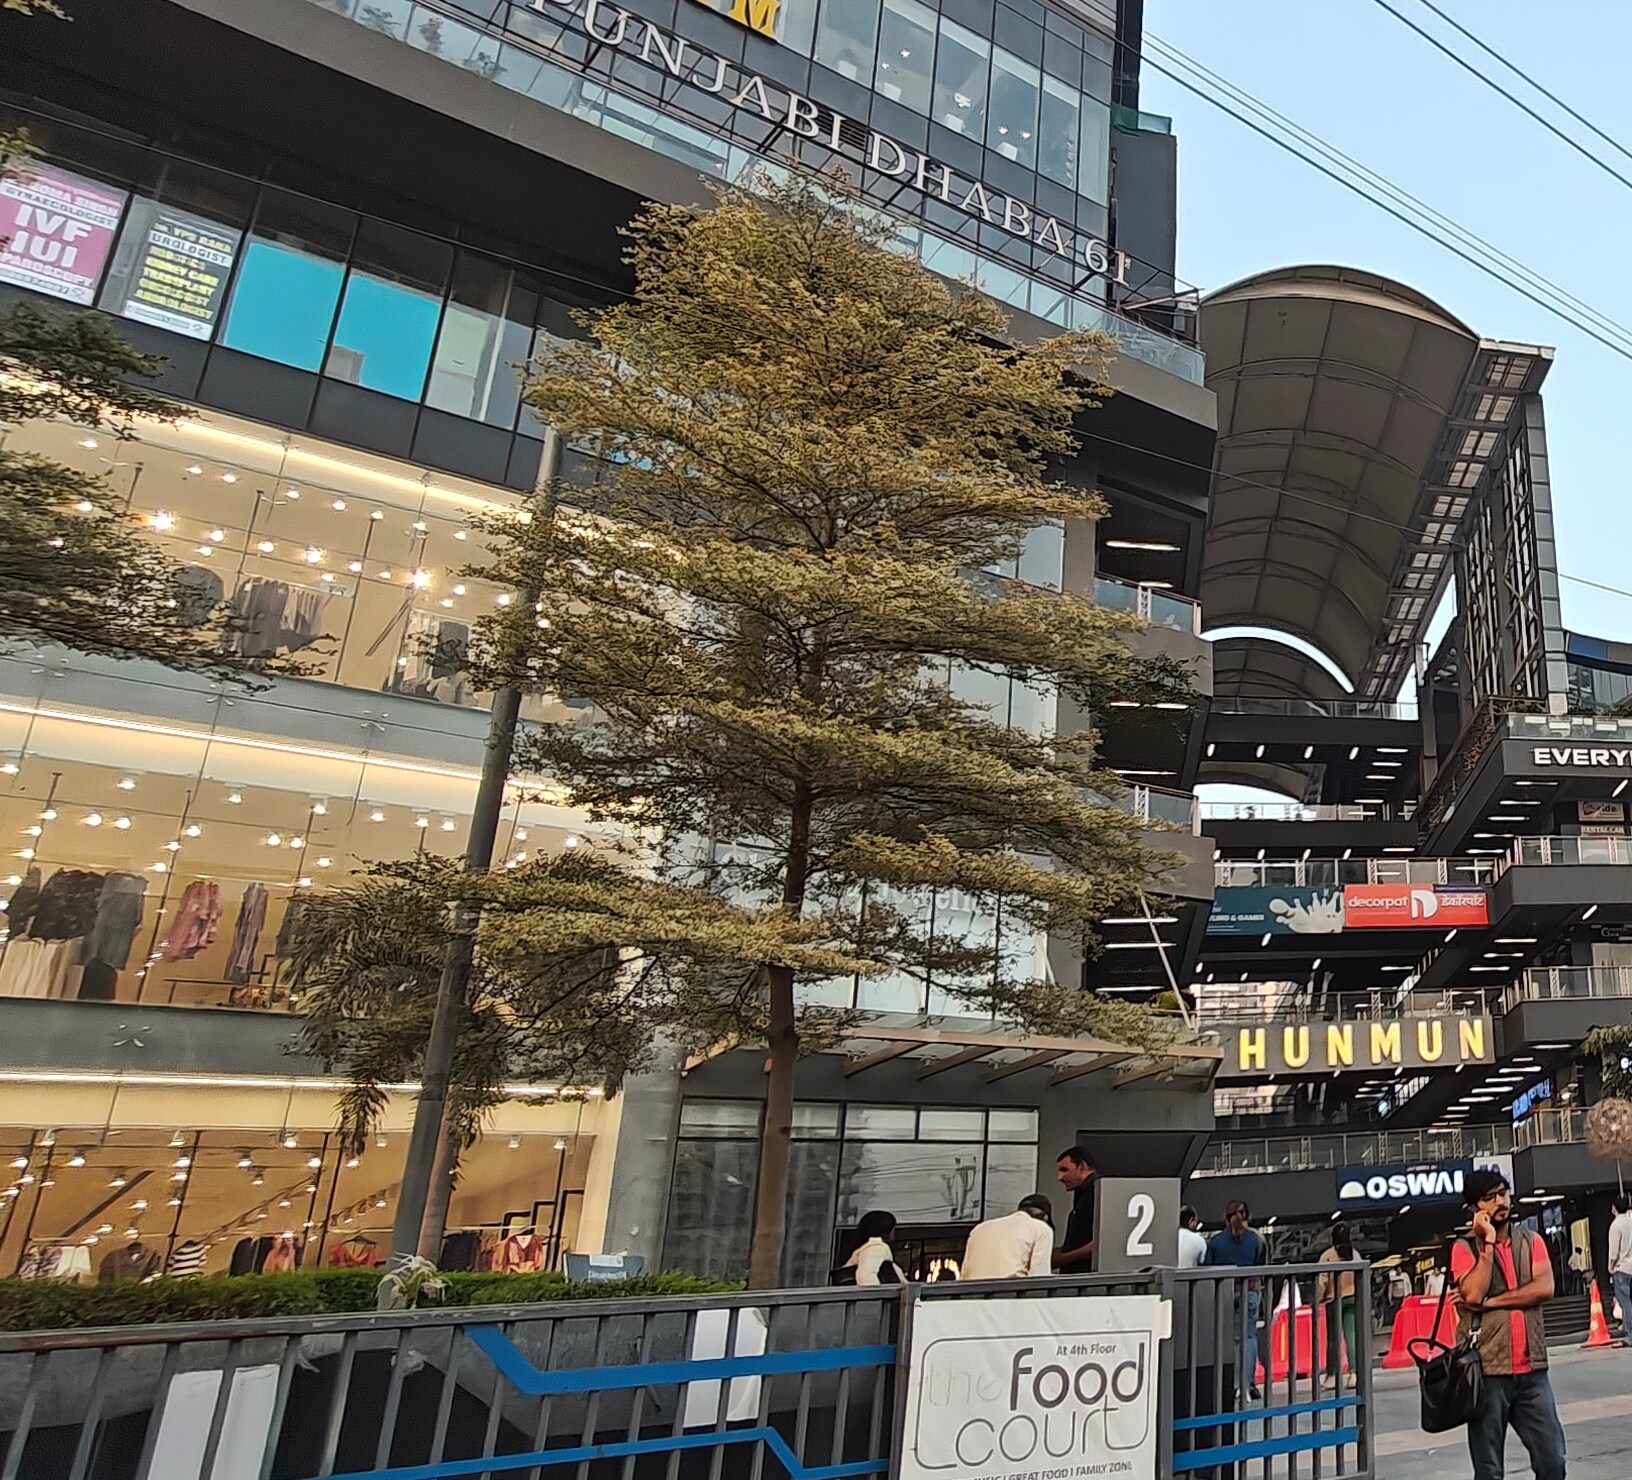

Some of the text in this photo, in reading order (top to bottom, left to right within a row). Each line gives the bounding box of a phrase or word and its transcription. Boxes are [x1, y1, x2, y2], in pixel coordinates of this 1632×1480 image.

[15, 203, 92, 242] IVF
[867, 130, 1067, 256] DHABA
[1084, 239, 1131, 287] 61
[11, 230, 77, 268] IUI
[152, 232, 227, 264] UROLOGIST
[1239, 1019, 1485, 1070] HUNMUN
[1126, 1193, 1155, 1256] 2
[1056, 1343, 1116, 1356] At 4th Floor
[1010, 1342, 1145, 1411] food
[956, 1395, 1125, 1467] court
[1042, 1468, 1068, 1480] FOOD
[1075, 1464, 1108, 1477] FAMILY
